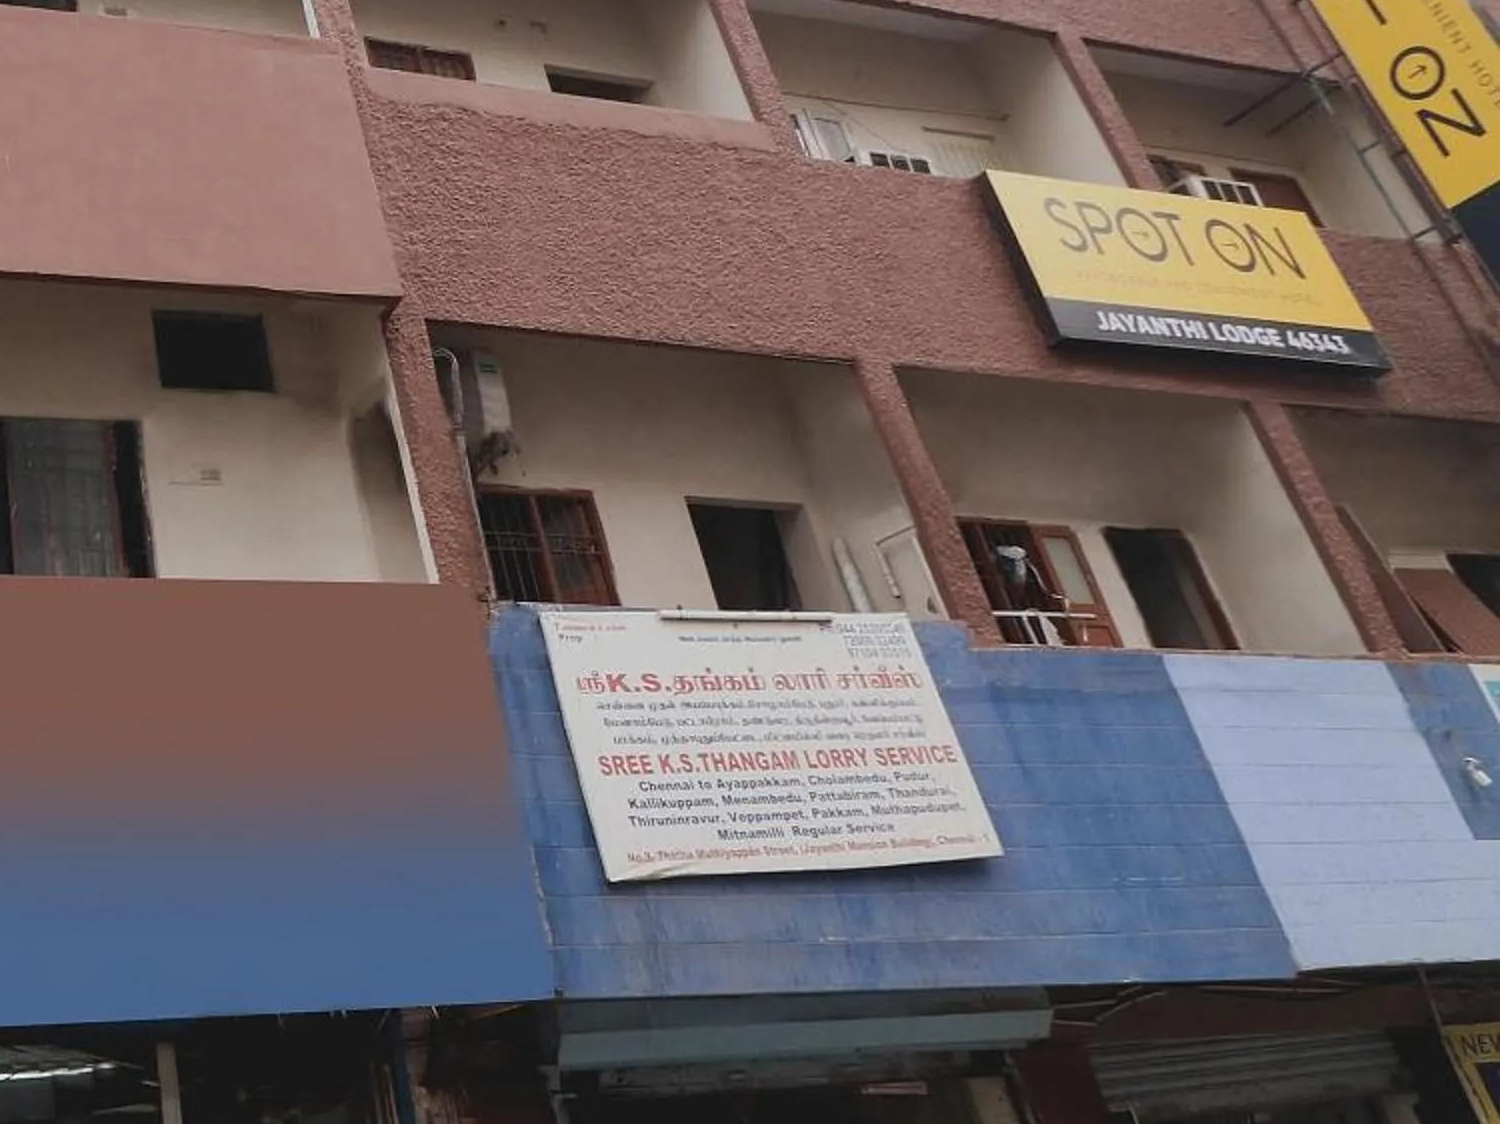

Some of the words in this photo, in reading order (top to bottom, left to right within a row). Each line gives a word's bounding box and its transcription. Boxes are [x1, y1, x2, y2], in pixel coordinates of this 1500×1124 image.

[1389, 45, 1486, 157] ON
[1043, 196, 1195, 266] SPOT
[1204, 218, 1308, 280] ON
[1096, 310, 1211, 342] JAYANTHI
[1207, 322, 1286, 348] LODGE
[597, 755, 653, 776] SREE
[803, 747, 869, 769] LORRY
[874, 744, 958, 766] SERVICE
[639, 779, 694, 792] Chennai
[699, 781, 712, 790] to
[791, 824, 846, 838] Regular
[847, 821, 895, 834] Service
